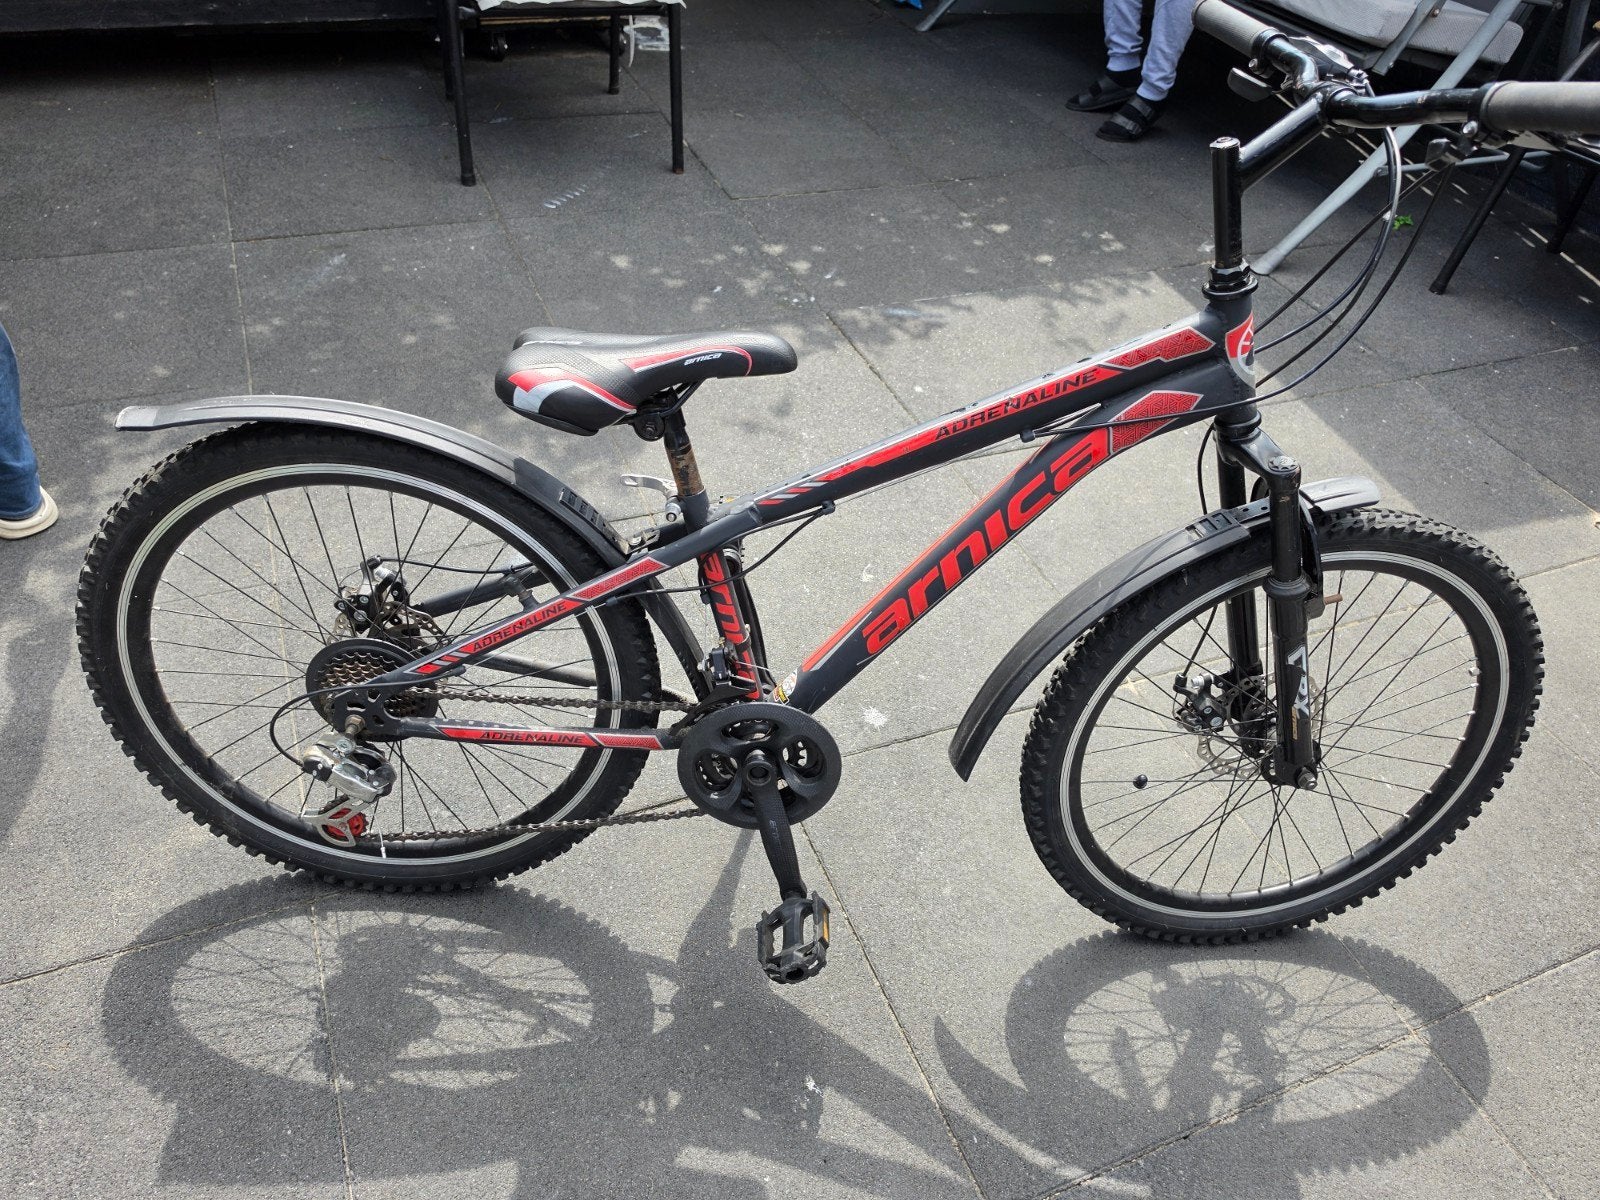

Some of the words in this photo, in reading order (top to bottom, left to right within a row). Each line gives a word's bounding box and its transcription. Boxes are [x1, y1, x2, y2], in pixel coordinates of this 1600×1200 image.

[684, 352, 722, 366] arnica
[935, 368, 1098, 441] ADRENALINE
[862, 427, 1109, 655] arnica
[473, 600, 567, 652] ADRENALINE
[479, 730, 583, 744] ADRENALINE
